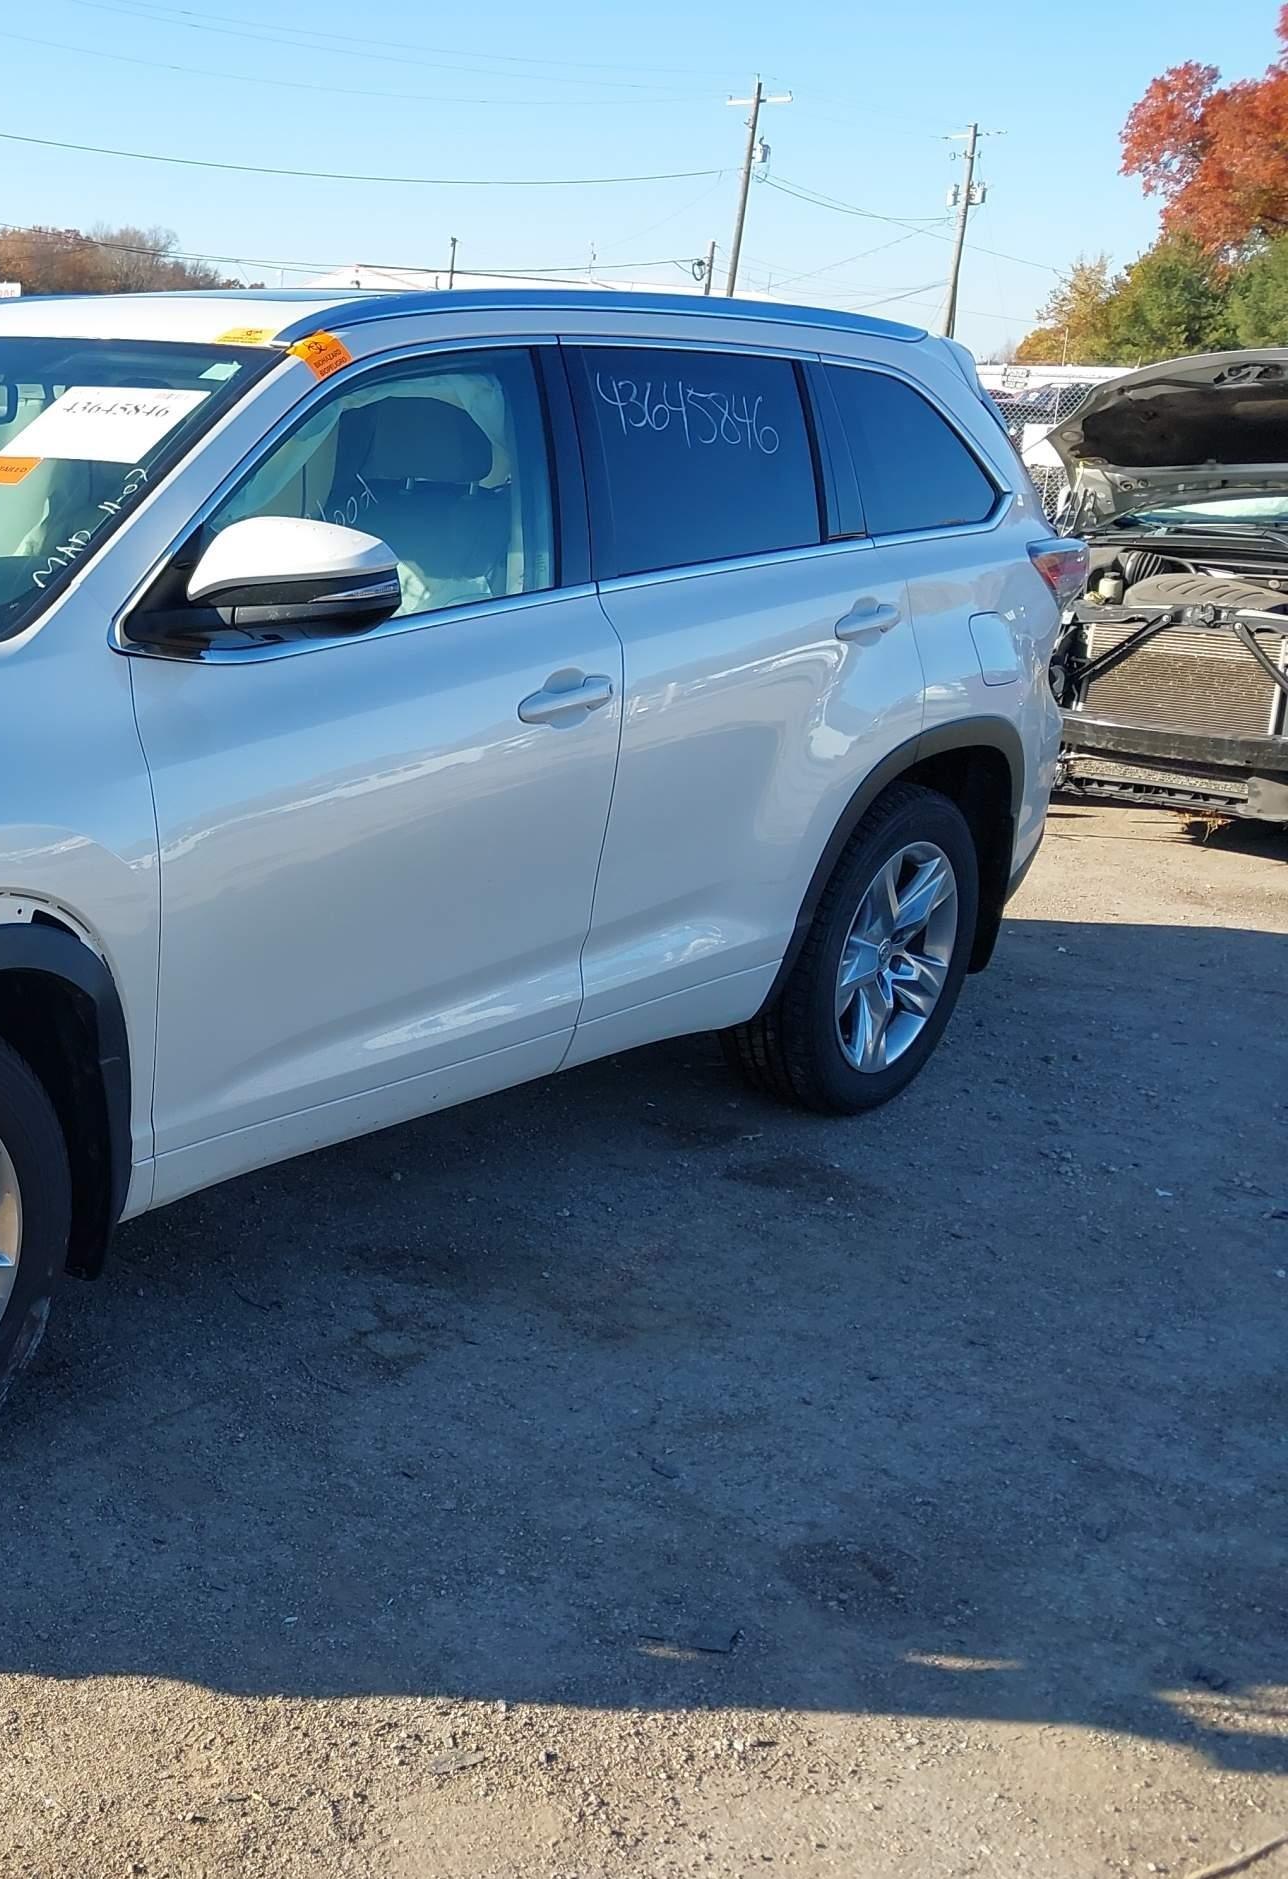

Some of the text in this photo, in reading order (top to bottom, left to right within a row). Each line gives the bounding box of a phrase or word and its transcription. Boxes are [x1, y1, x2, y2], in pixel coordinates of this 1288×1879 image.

[62, 400, 172, 418] 43645846
[595, 371, 780, 455] 43645846
[32, 530, 92, 589] MAD
